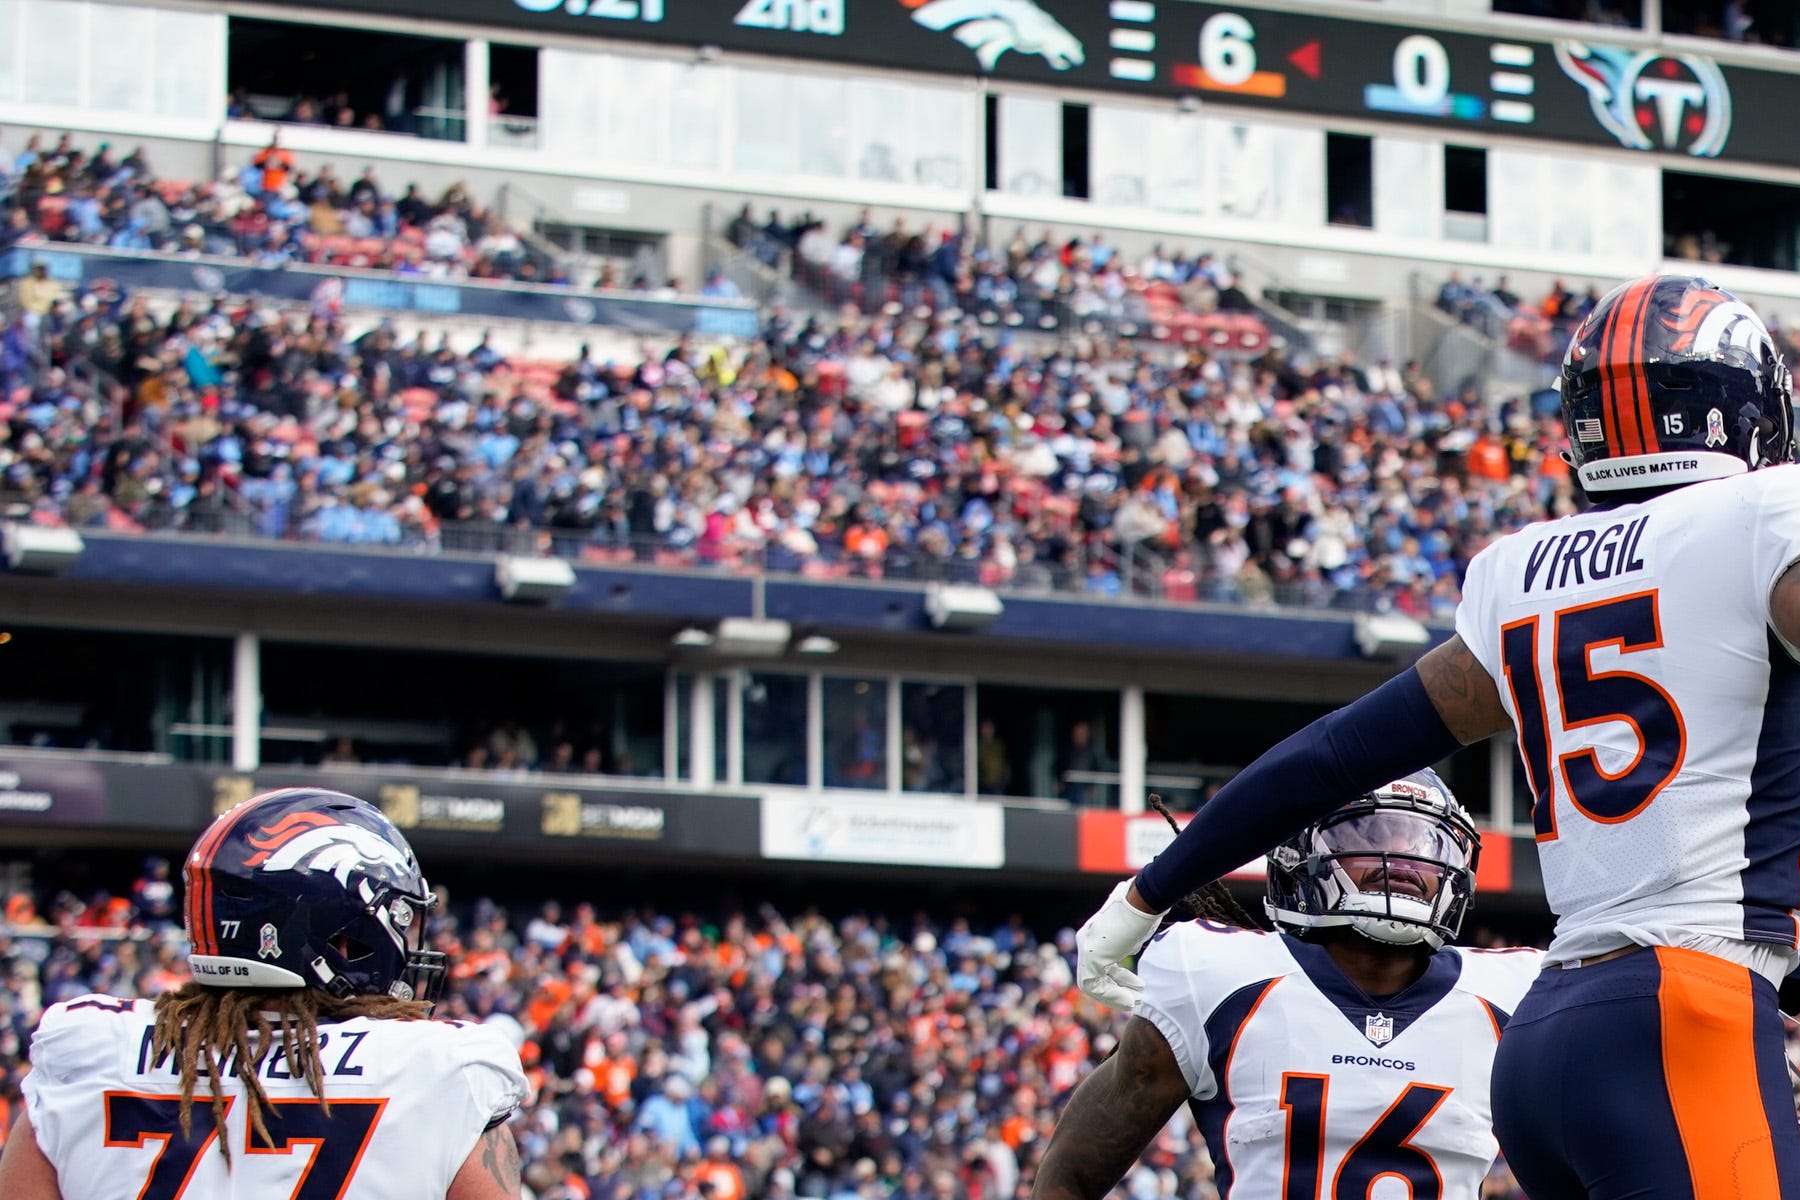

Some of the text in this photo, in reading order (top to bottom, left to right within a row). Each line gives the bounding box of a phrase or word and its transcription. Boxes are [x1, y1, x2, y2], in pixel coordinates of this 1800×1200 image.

[1199, 13, 1255, 85] 6
[1393, 35, 1450, 103] 0
[1662, 413, 1684, 435] 15
[1585, 460, 1698, 482] BLACK LIVES MATTER
[1523, 514, 1650, 594] VIRGIL
[1501, 588, 1687, 843] 15
[220, 920, 240, 939] 77
[202, 965, 217, 975] ALL
[219, 966, 231, 976] OF
[234, 967, 249, 976] US
[1331, 1054, 1416, 1072] BRONCOS
